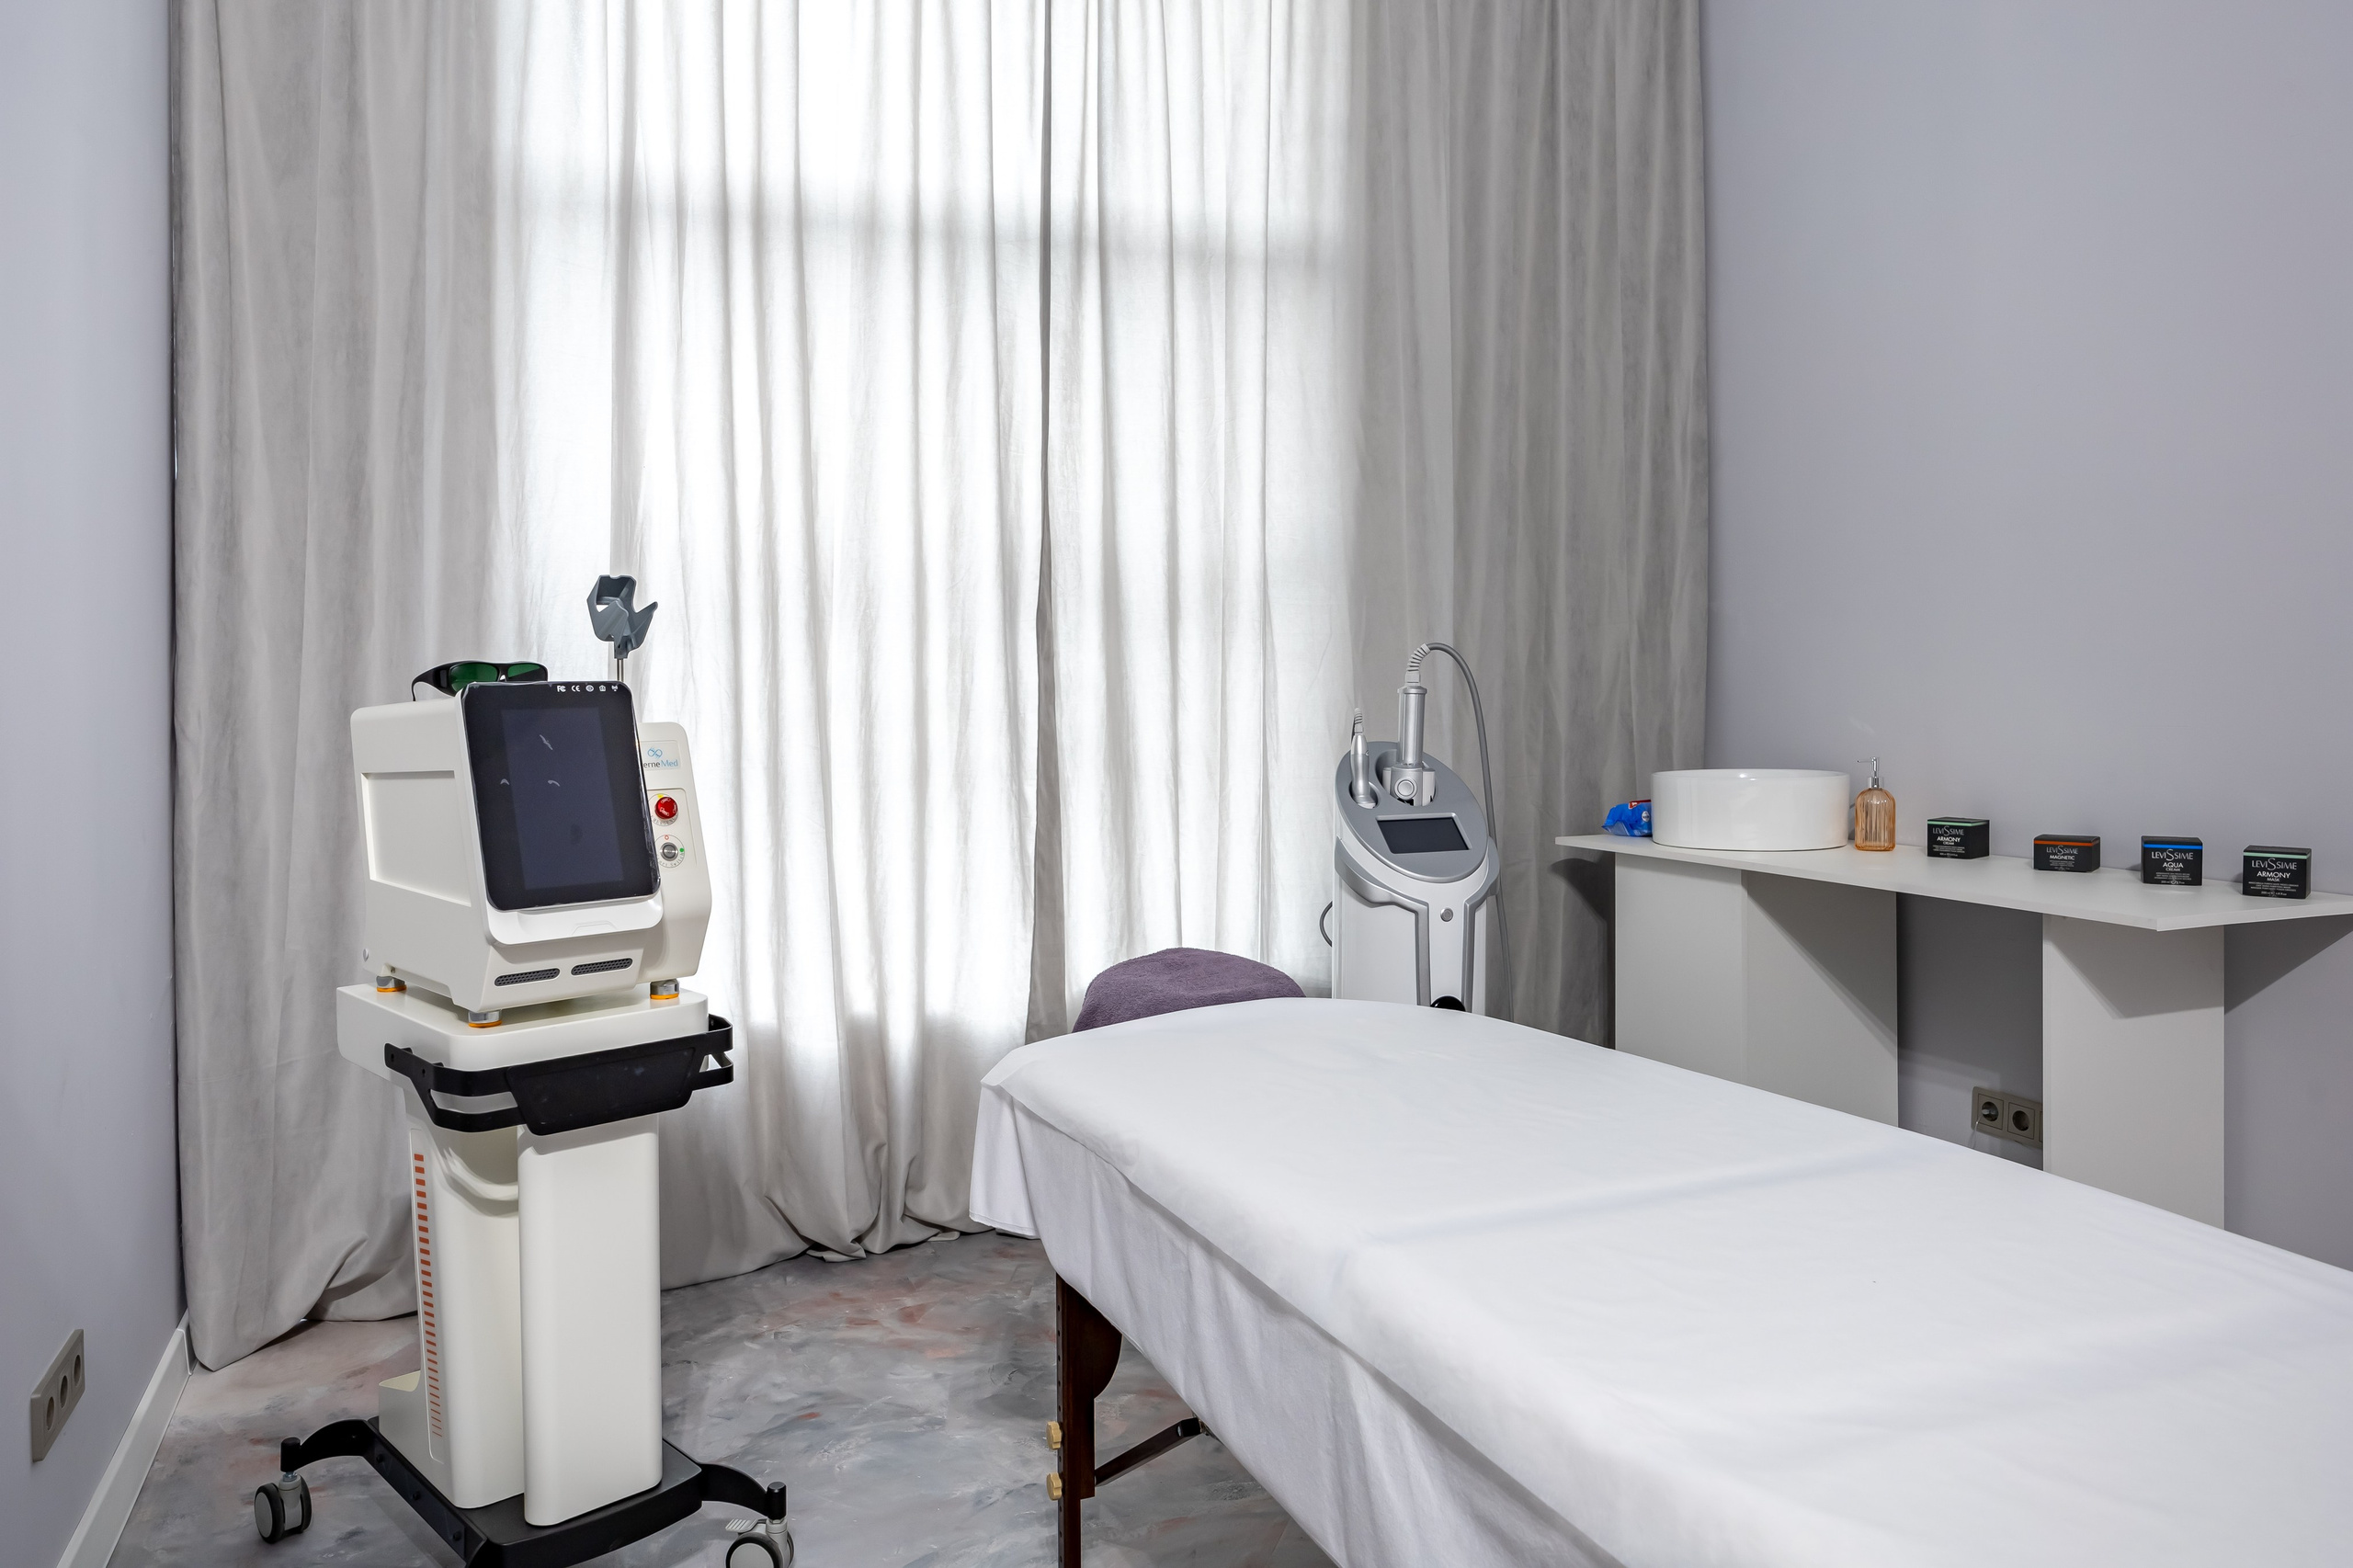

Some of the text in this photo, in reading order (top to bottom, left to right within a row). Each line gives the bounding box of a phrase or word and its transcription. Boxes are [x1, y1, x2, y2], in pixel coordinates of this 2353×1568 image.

[2151, 848, 2194, 861] LEVISSIME
[2251, 858, 2297, 870] LEVISSIME
[2256, 870, 2290, 879] ARMONY
